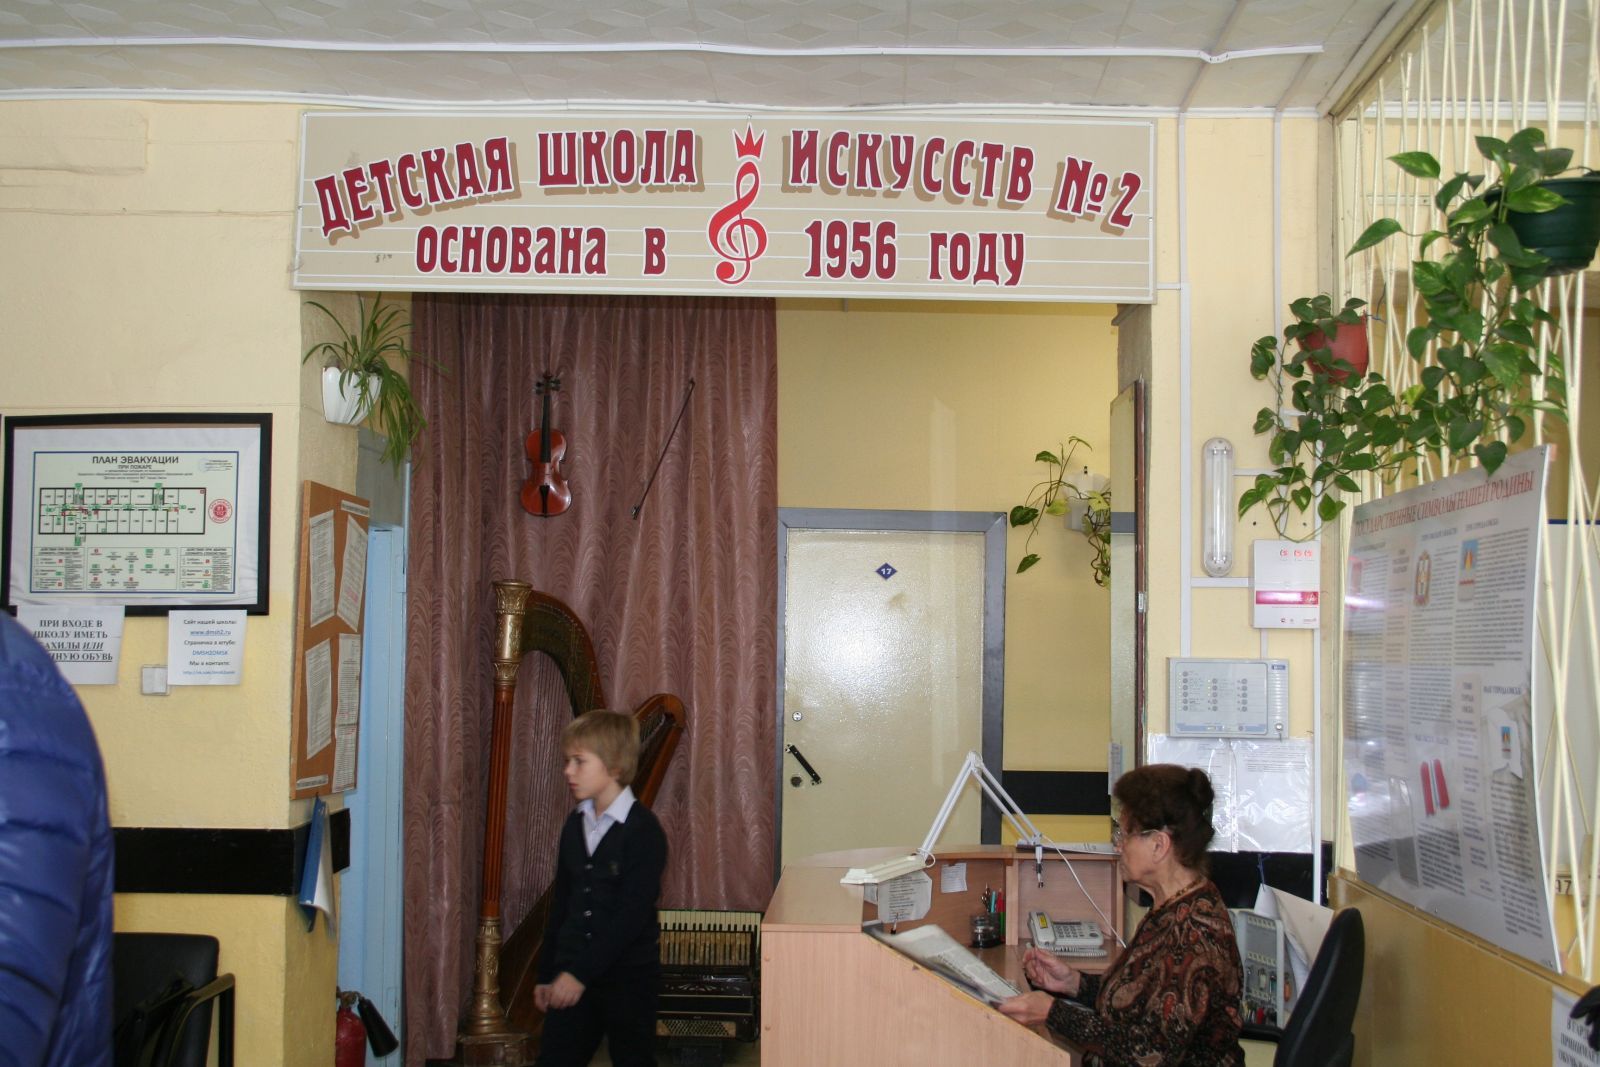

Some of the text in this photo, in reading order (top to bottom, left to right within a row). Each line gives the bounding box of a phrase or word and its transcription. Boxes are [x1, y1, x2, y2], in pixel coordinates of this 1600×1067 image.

[315, 136, 514, 237] ДЕТСКАЯ
[538, 130, 696, 187] ШКОЛА
[790, 129, 1035, 203] ИСКУССТВ
[805, 220, 898, 280] 1956
[92, 456, 179, 465] ПЛАН ЭВАКУАЦИИ
[1491, 470, 1535, 500] РОДИНЫ
[40, 619, 103, 628] ПРИ ВХОДЕ В
[33, 630, 108, 639] ШКОЛУ ИМЕТЬ
[45, 641, 104, 650] АХИЛЫ ИЛИ
[82, 652, 113, 661] ОБУВЬ
